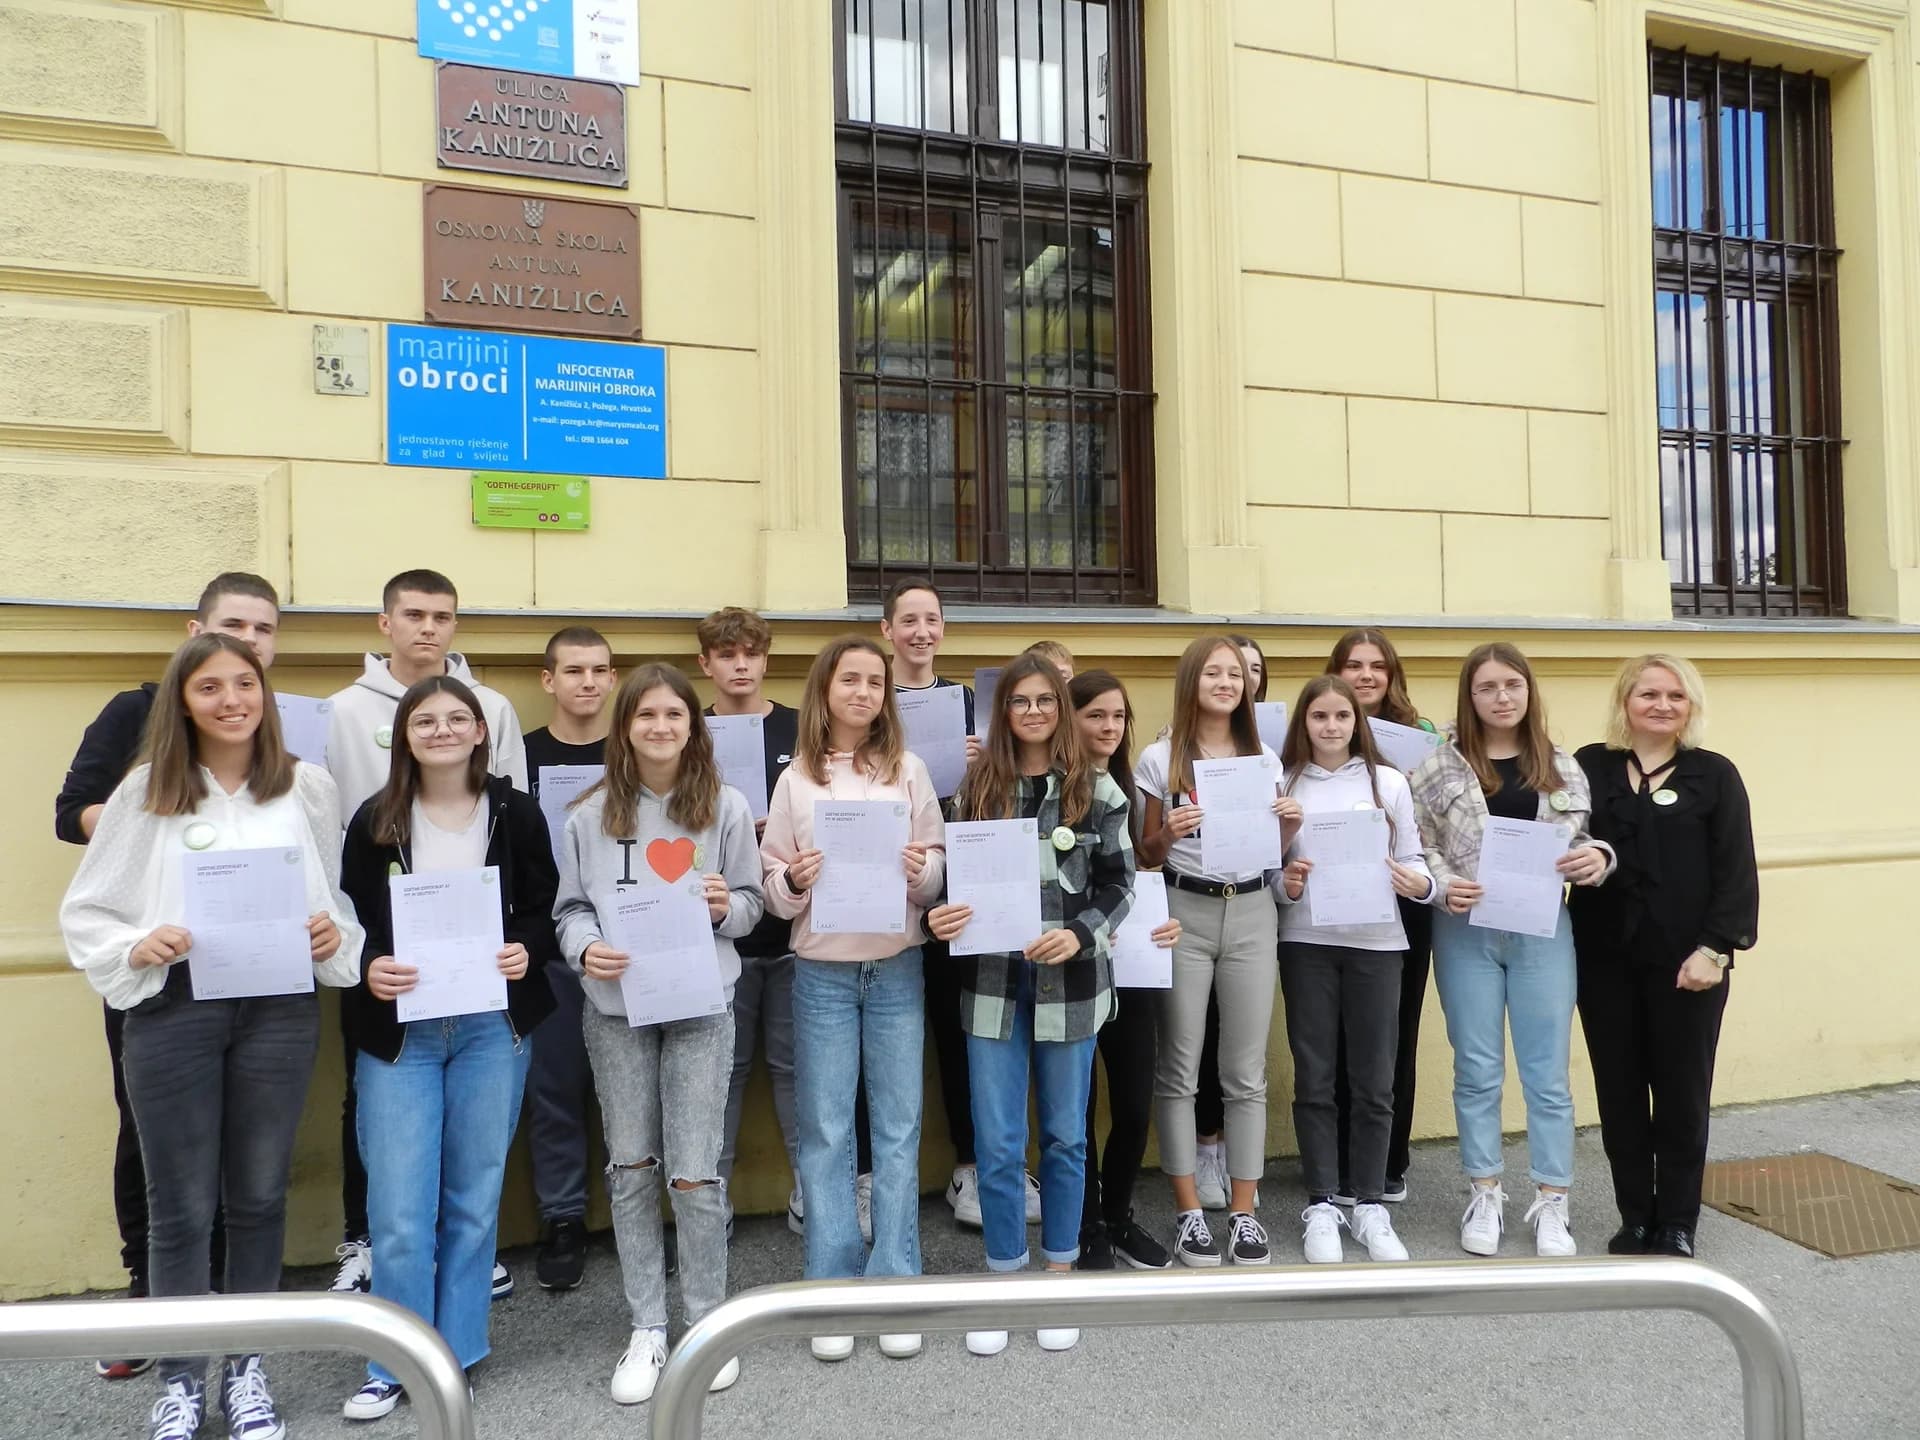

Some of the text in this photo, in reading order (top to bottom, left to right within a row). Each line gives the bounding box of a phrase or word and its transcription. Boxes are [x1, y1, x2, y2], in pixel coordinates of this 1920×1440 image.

[495, 77, 570, 103] ULICA
[464, 99, 604, 139] ANTUNA
[443, 126, 621, 172] KANIŽLIĆA
[435, 218, 543, 246] OSNOVNA
[489, 253, 582, 278] ANTUNA
[440, 277, 630, 318] KANIŽLIĆA
[399, 335, 509, 368] marijini
[398, 361, 509, 394] obroci
[557, 362, 635, 380] INFOCENTAR
[535, 377, 657, 398] MARIJINIH OBROKA
[398, 434, 510, 450] jednostavno rješenje
[399, 447, 411, 457] za
[422, 447, 446, 460] glad
[473, 450, 510, 462] svijetu
[616, 839, 638, 885] I
